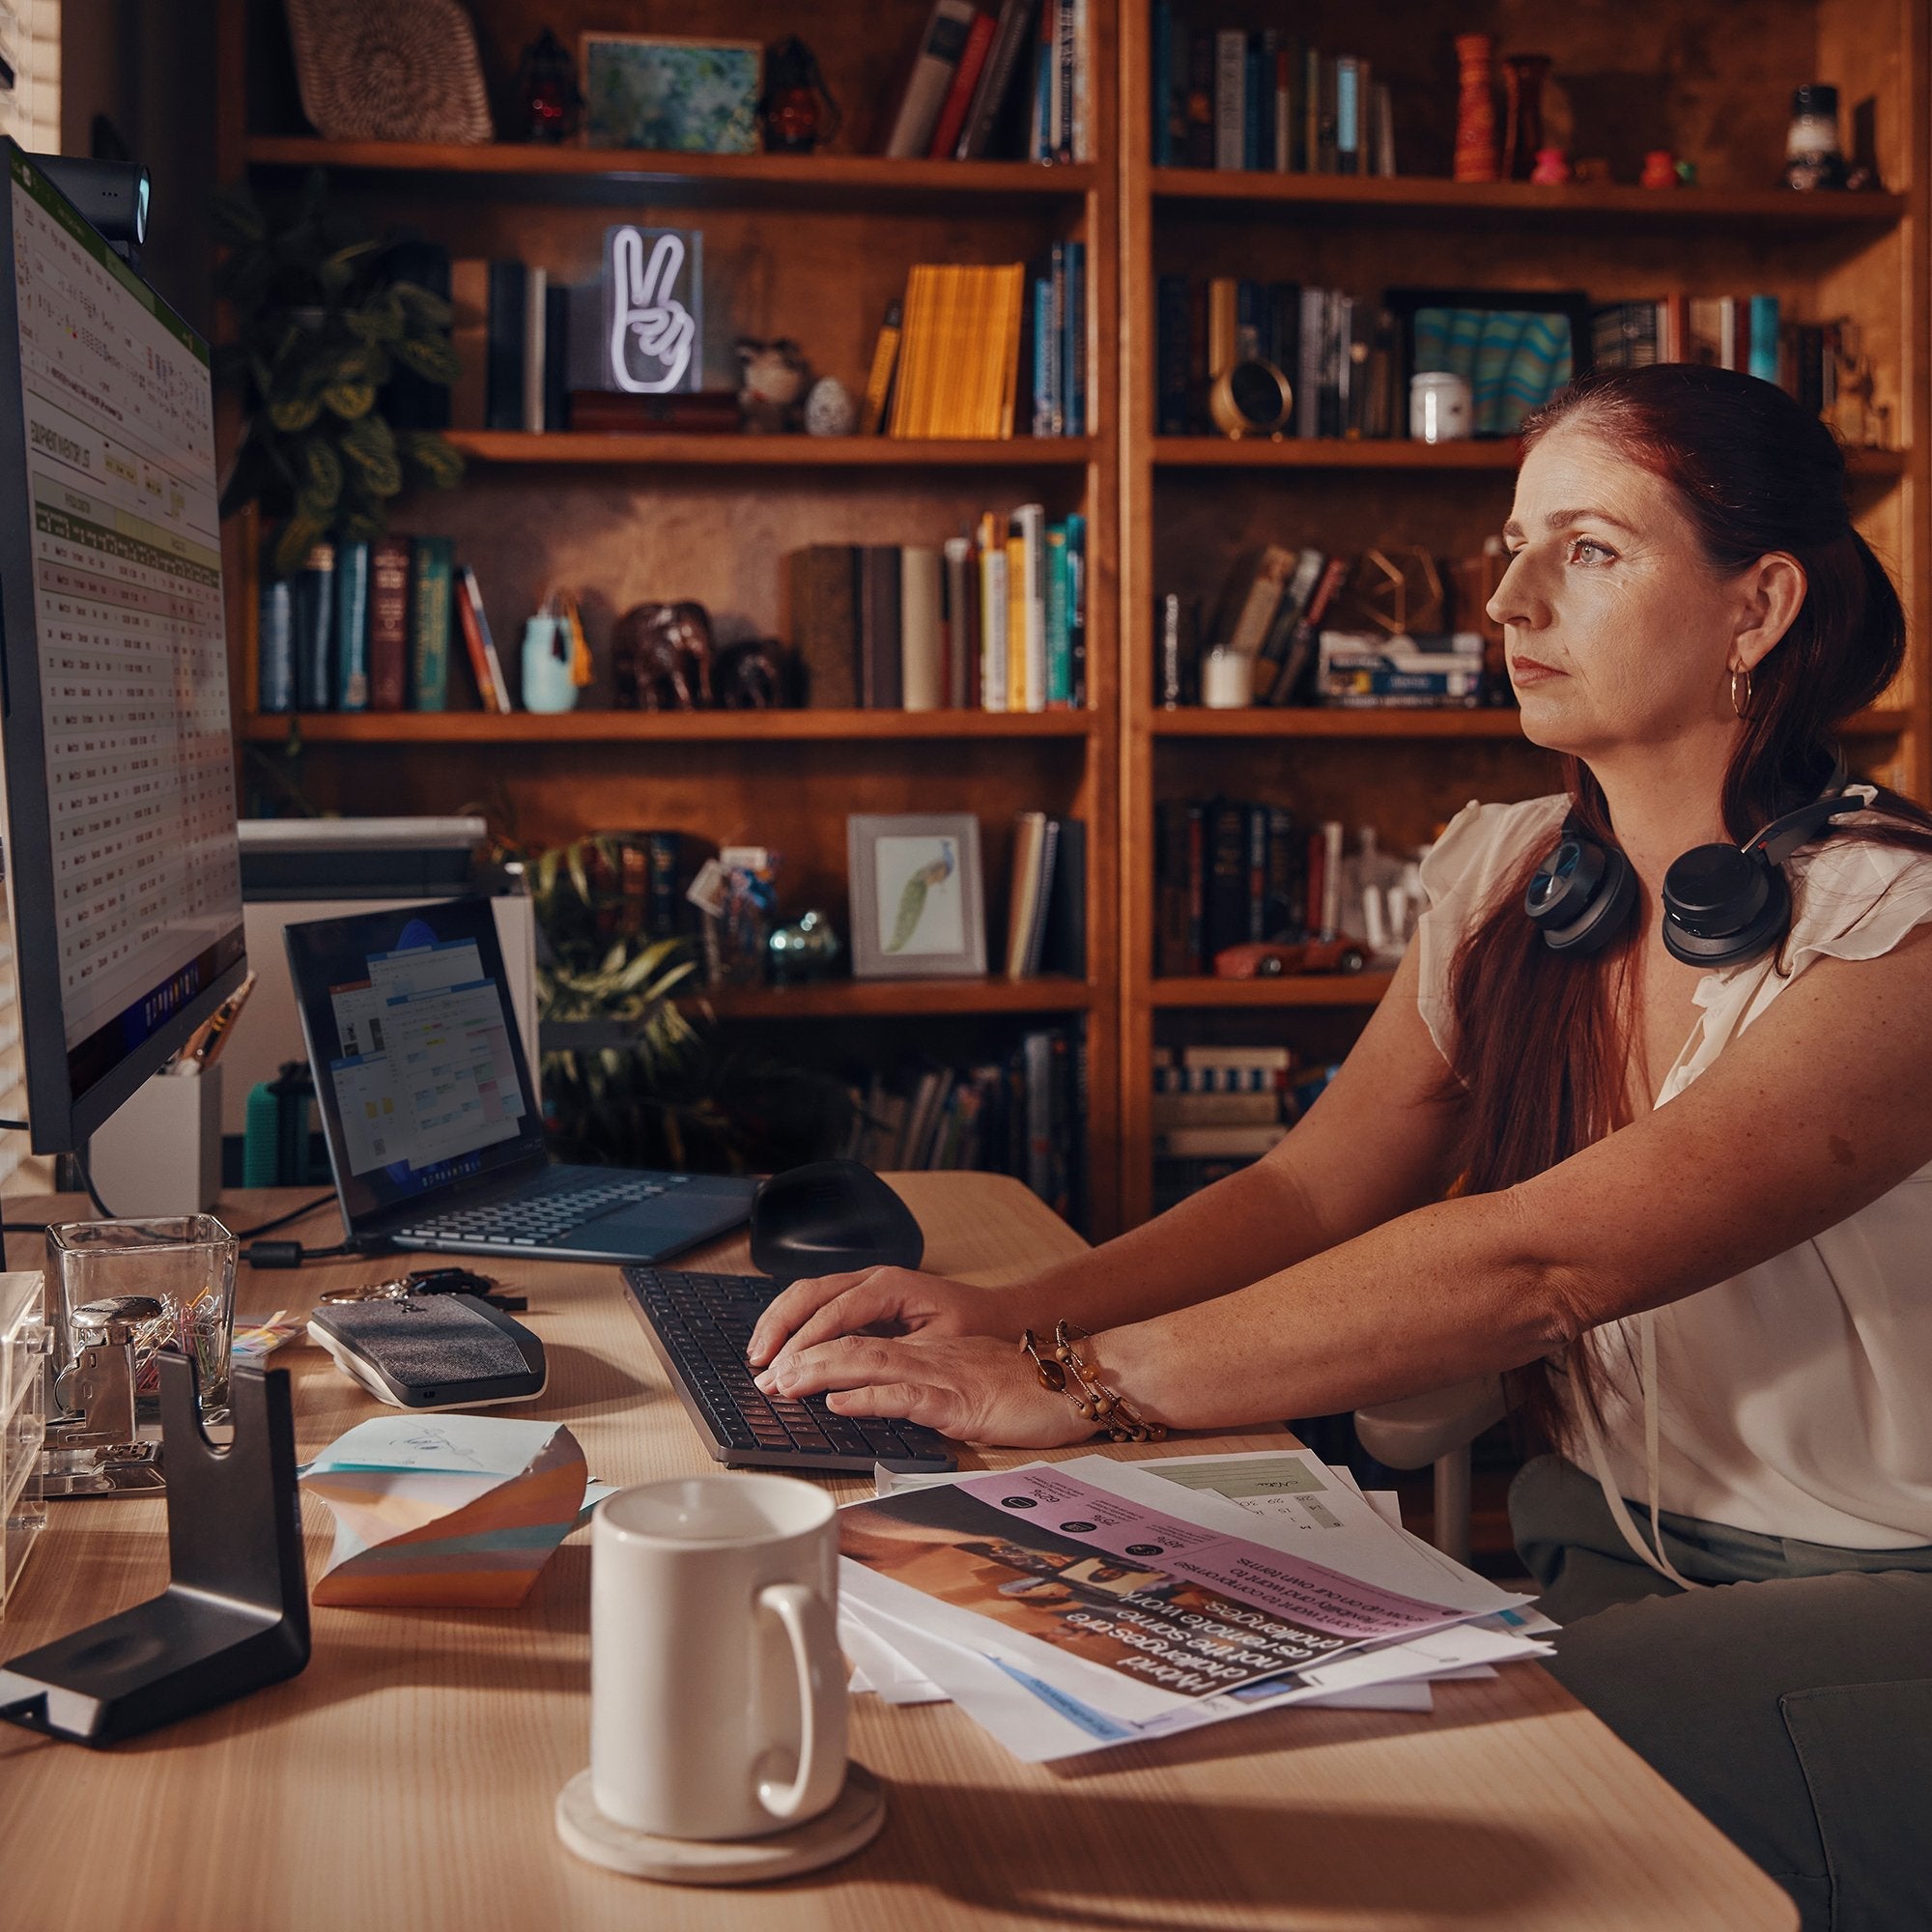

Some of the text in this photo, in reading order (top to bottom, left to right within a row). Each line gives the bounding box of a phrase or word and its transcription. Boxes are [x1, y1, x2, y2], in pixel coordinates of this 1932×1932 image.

[1030, 1489, 1060, 1504] 62%
[1091, 1514, 1121, 1526] 75%
[1230, 1569, 1249, 1578] to
[1236, 1557, 1283, 1577] terms
[1174, 1561, 1264, 1597] compromise
[1245, 1574, 1285, 1593] want
[1280, 1575, 1315, 1589] own
[1261, 1594, 1282, 1605] to
[1282, 1589, 1316, 1603] and
[1311, 1587, 1343, 1600] our
[1340, 1597, 1363, 1606] on
[1277, 1601, 1320, 1618] want
[1361, 1605, 1384, 1614] up
[1118, 1590, 1314, 1660] as remote work
[1317, 1615, 1359, 1629] don't
[1066, 1612, 1248, 1679] challenges are
[1117, 1609, 1283, 1669] not the same
[1117, 1656, 1216, 1691] Hybrid
